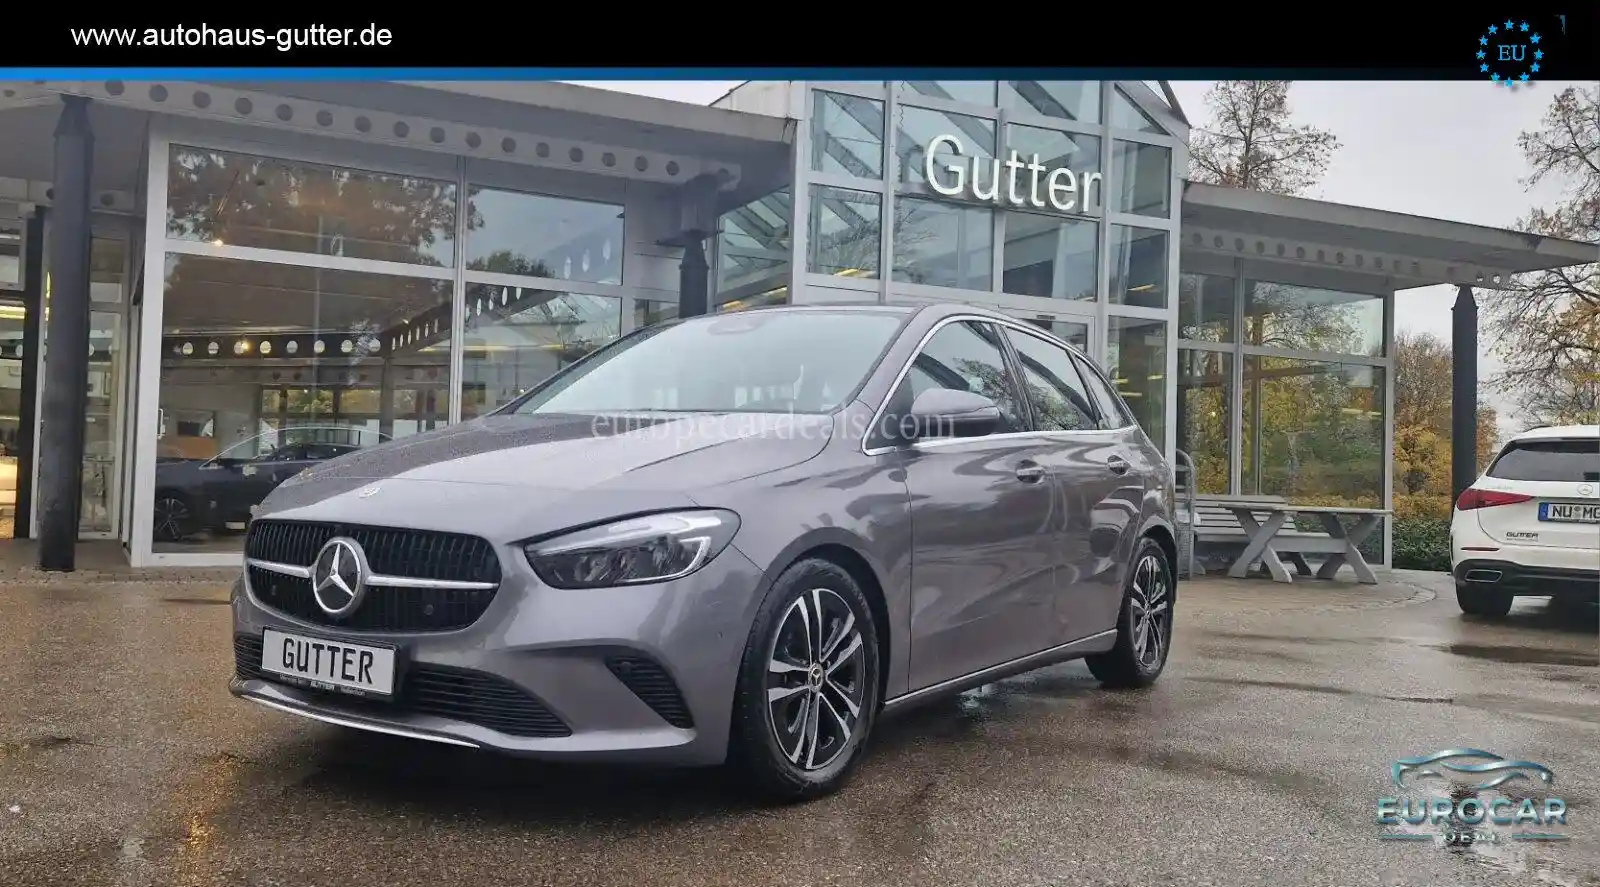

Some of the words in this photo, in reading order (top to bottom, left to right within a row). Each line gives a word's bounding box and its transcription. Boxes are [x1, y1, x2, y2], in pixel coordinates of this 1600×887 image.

[926, 134, 1102, 213] Gutter
[1552, 505, 1573, 518] NU
[283, 637, 373, 685] GUTTER
